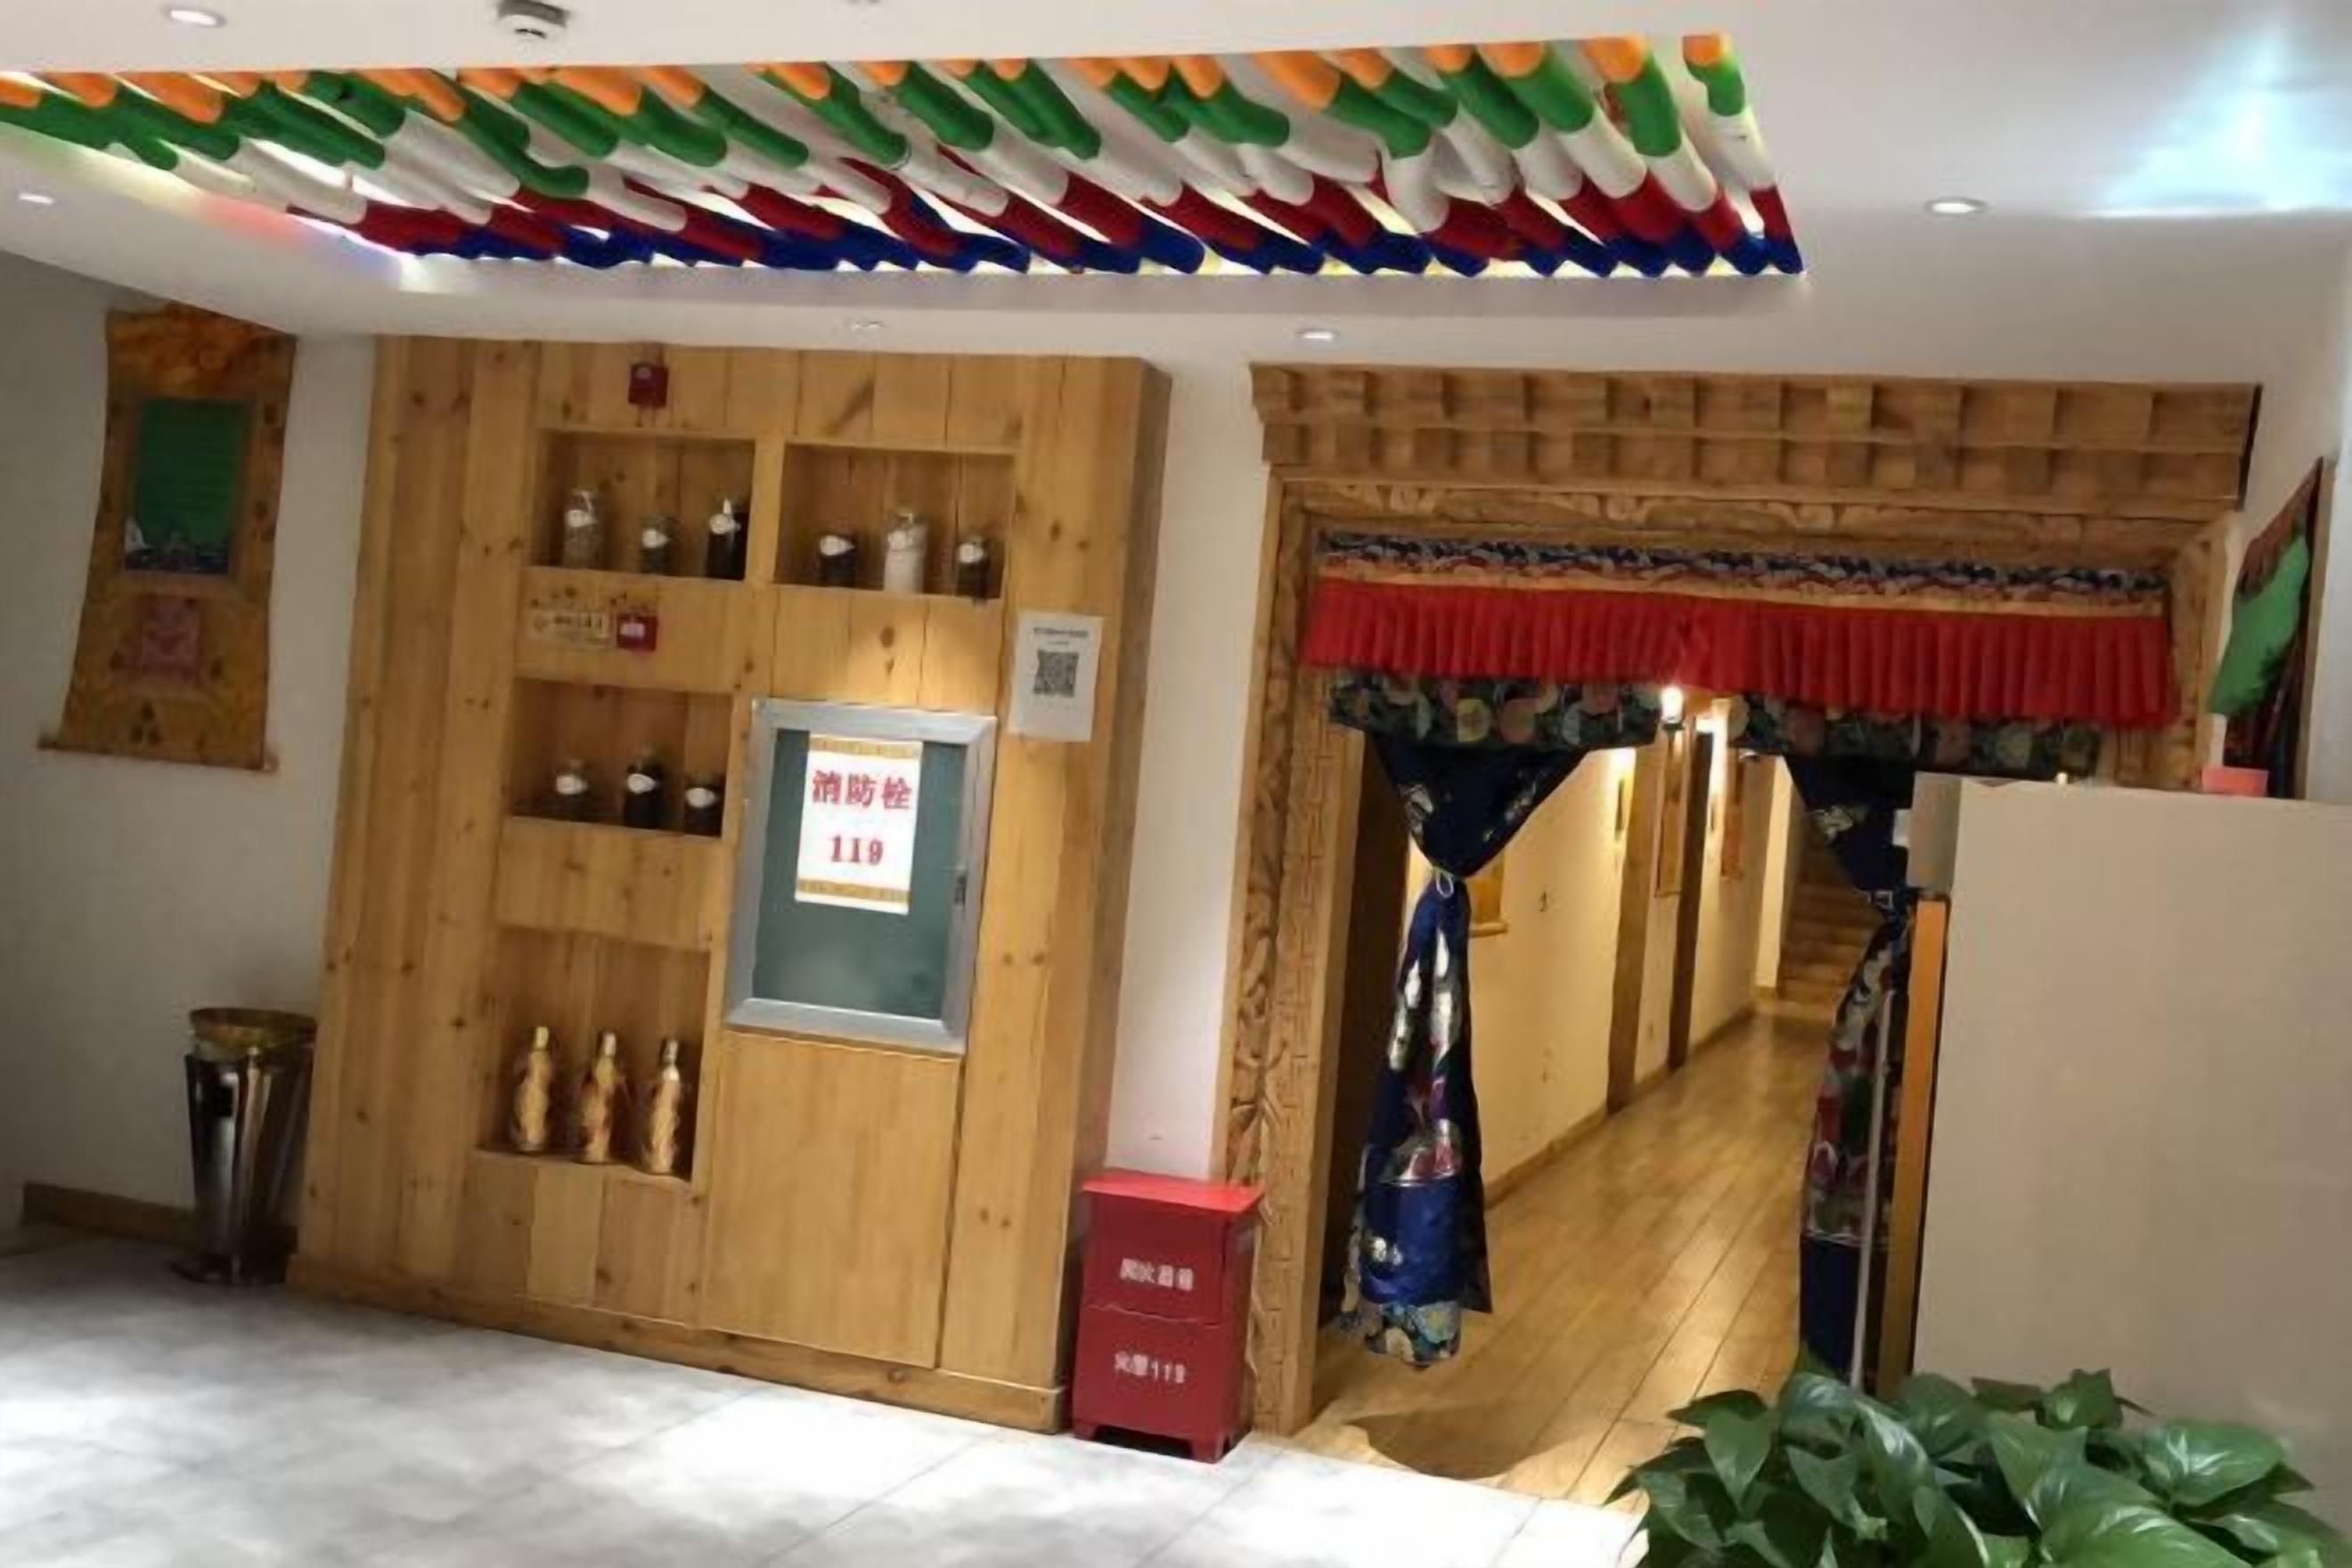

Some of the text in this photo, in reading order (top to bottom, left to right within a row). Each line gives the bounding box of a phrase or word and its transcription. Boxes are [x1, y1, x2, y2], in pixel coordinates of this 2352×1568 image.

[812, 770, 912, 810] 消防栓
[829, 835, 884, 866] 119
